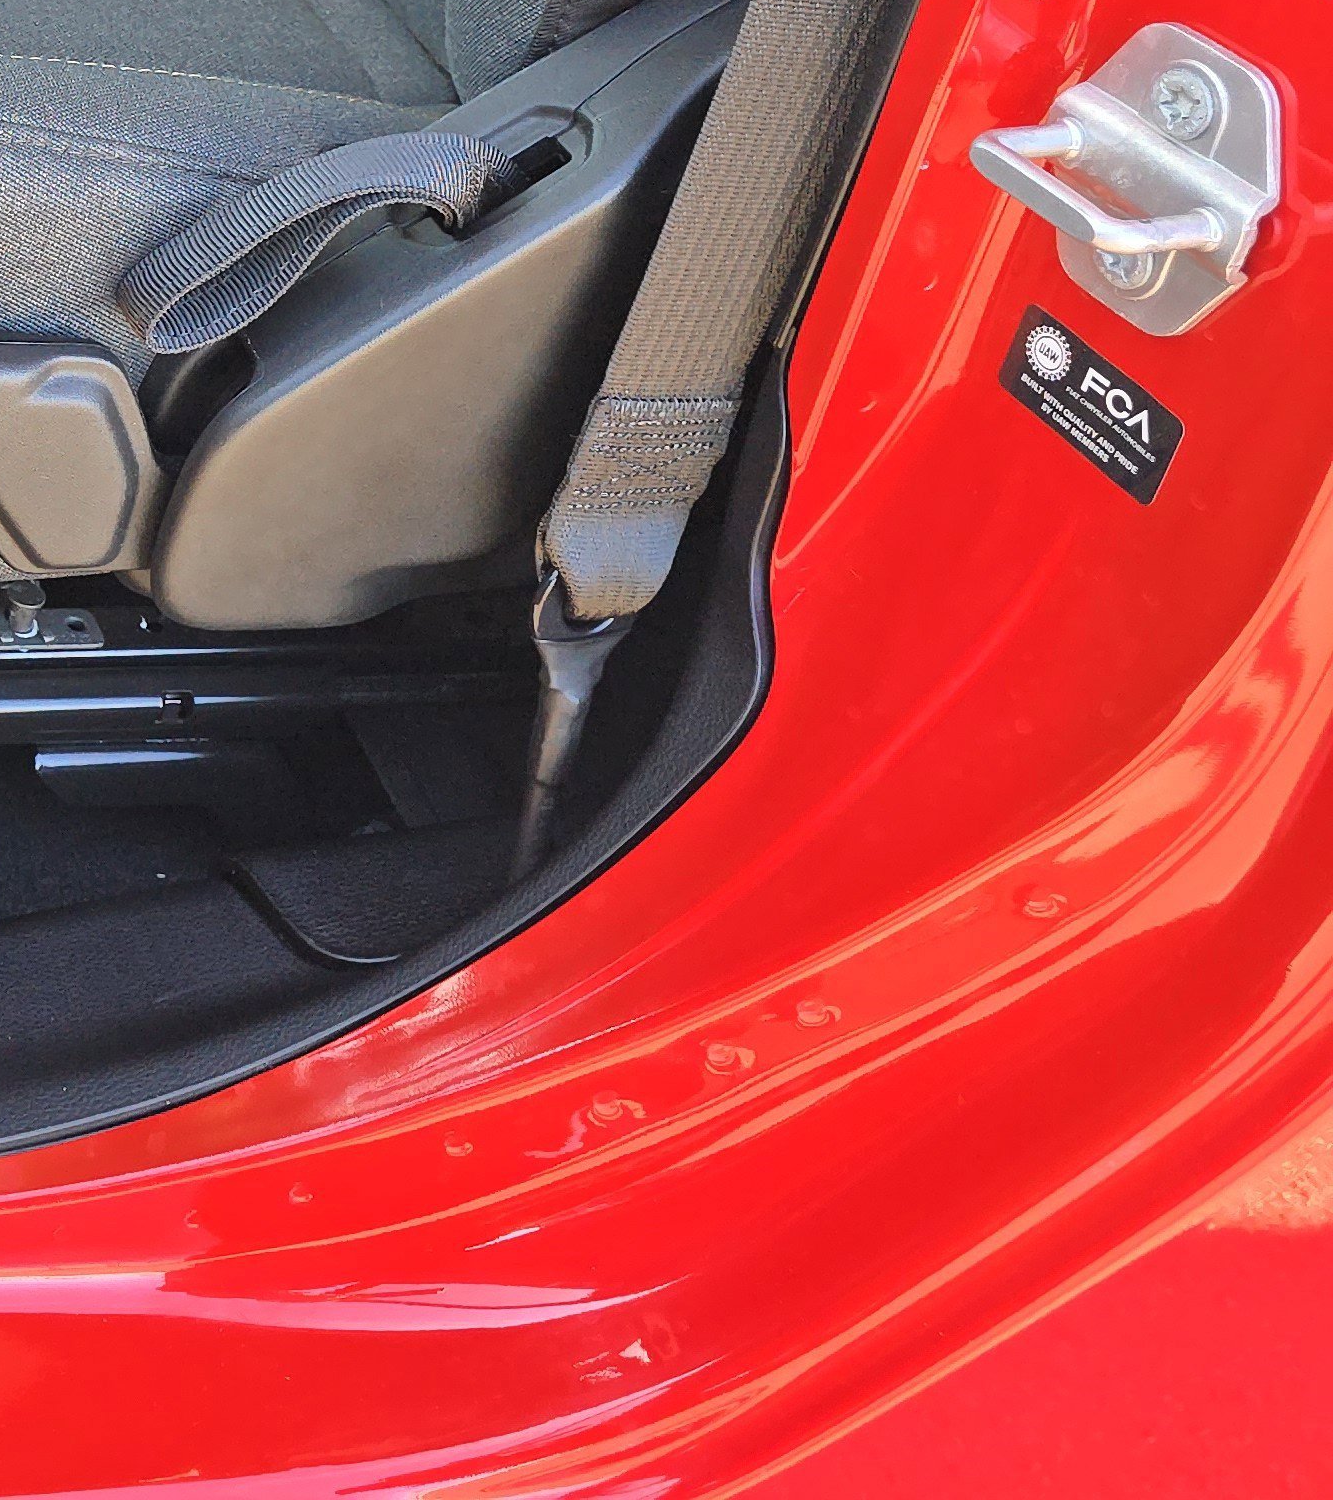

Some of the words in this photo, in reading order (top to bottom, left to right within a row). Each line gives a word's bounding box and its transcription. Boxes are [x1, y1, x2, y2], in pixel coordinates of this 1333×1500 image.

[1038, 342, 1060, 364] UAW
[1020, 372, 1045, 395] BUILT
[1043, 391, 1063, 413] WITH
[1063, 408, 1099, 438] QUALITY
[1096, 436, 1116, 454] AND
[1113, 450, 1139, 475] PRIDE
[1041, 402, 1053, 416] BY
[1051, 412, 1072, 430] UAW
[1070, 428, 1110, 463] MEMBERS
[1079, 398, 1114, 426] CHRYSLER
[1112, 424, 1157, 463] AUTOMOBILES
[1080, 367, 1149, 444] FCA
